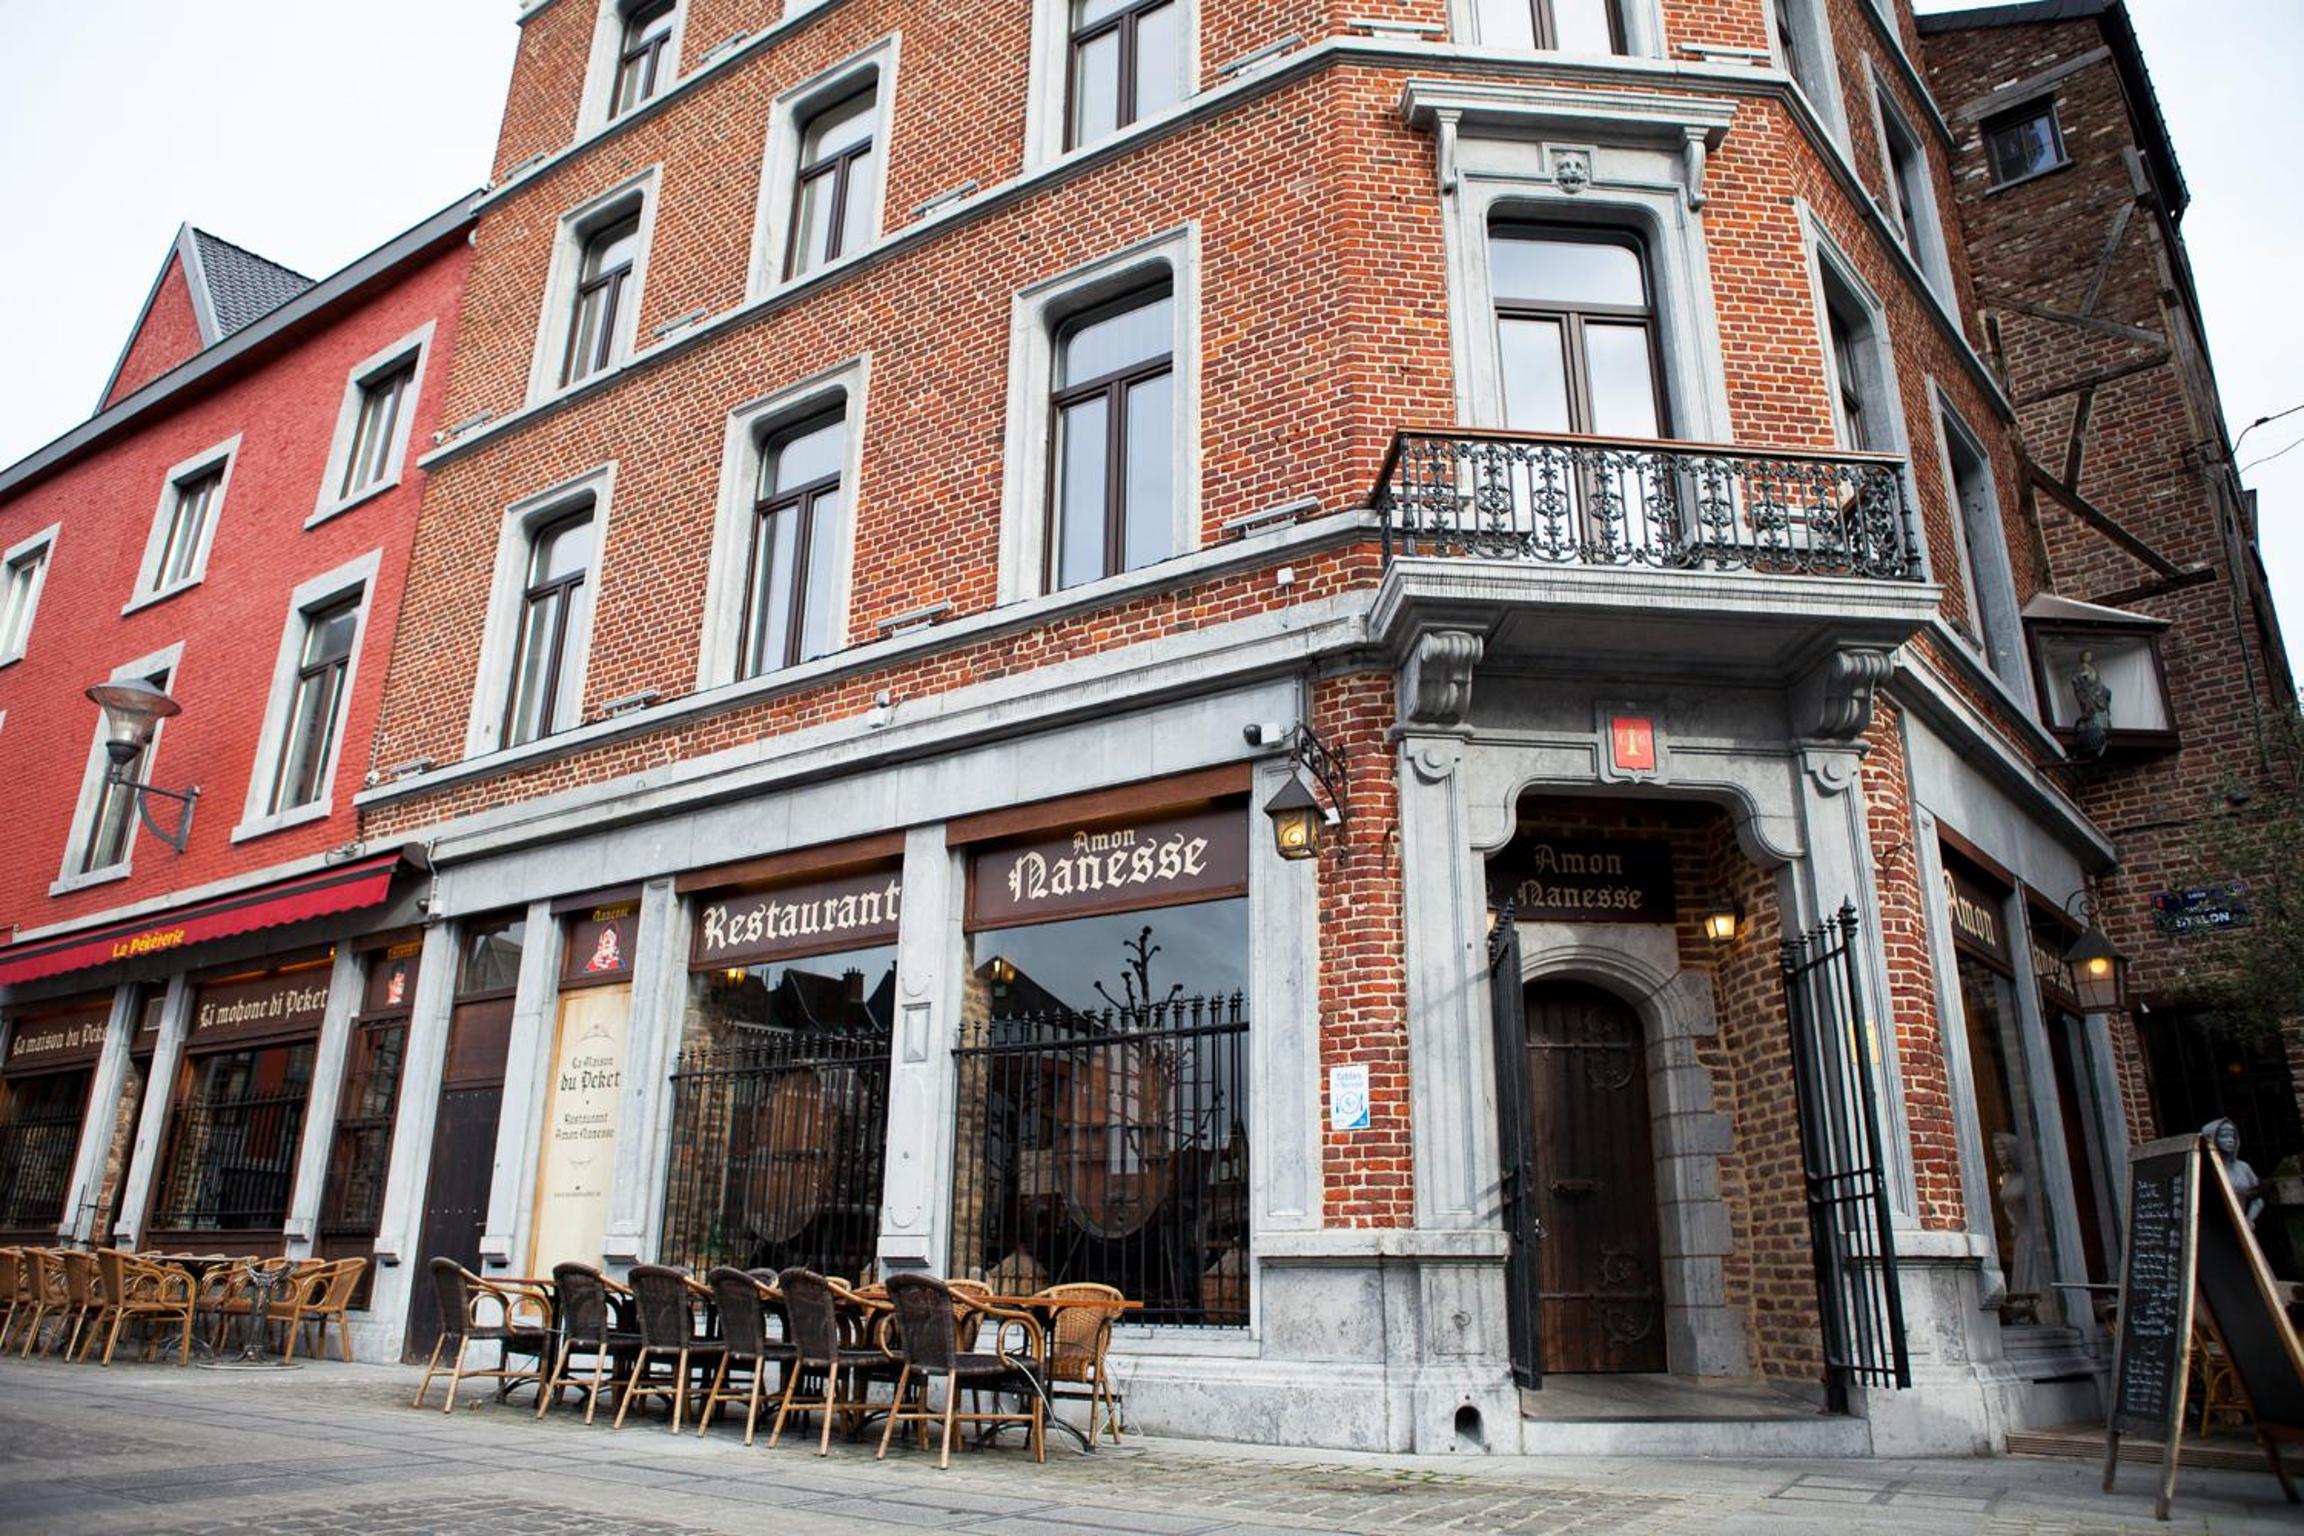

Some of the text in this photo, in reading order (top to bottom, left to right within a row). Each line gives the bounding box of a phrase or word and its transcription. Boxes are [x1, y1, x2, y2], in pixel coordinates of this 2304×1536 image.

[1073, 829, 1135, 855] Amon
[1008, 833, 1208, 902] Nanesse
[1535, 844, 1623, 875] Amon
[1517, 879, 1643, 909] Nanesse
[1942, 869, 1996, 947] Amon
[703, 879, 901, 950] Restaurant
[112, 943, 128, 958] La
[286, 986, 328, 1019] Peket
[26, 1029, 64, 1052] maison
[66, 1025, 80, 1047] du
[560, 1070, 620, 1093] du Peket
